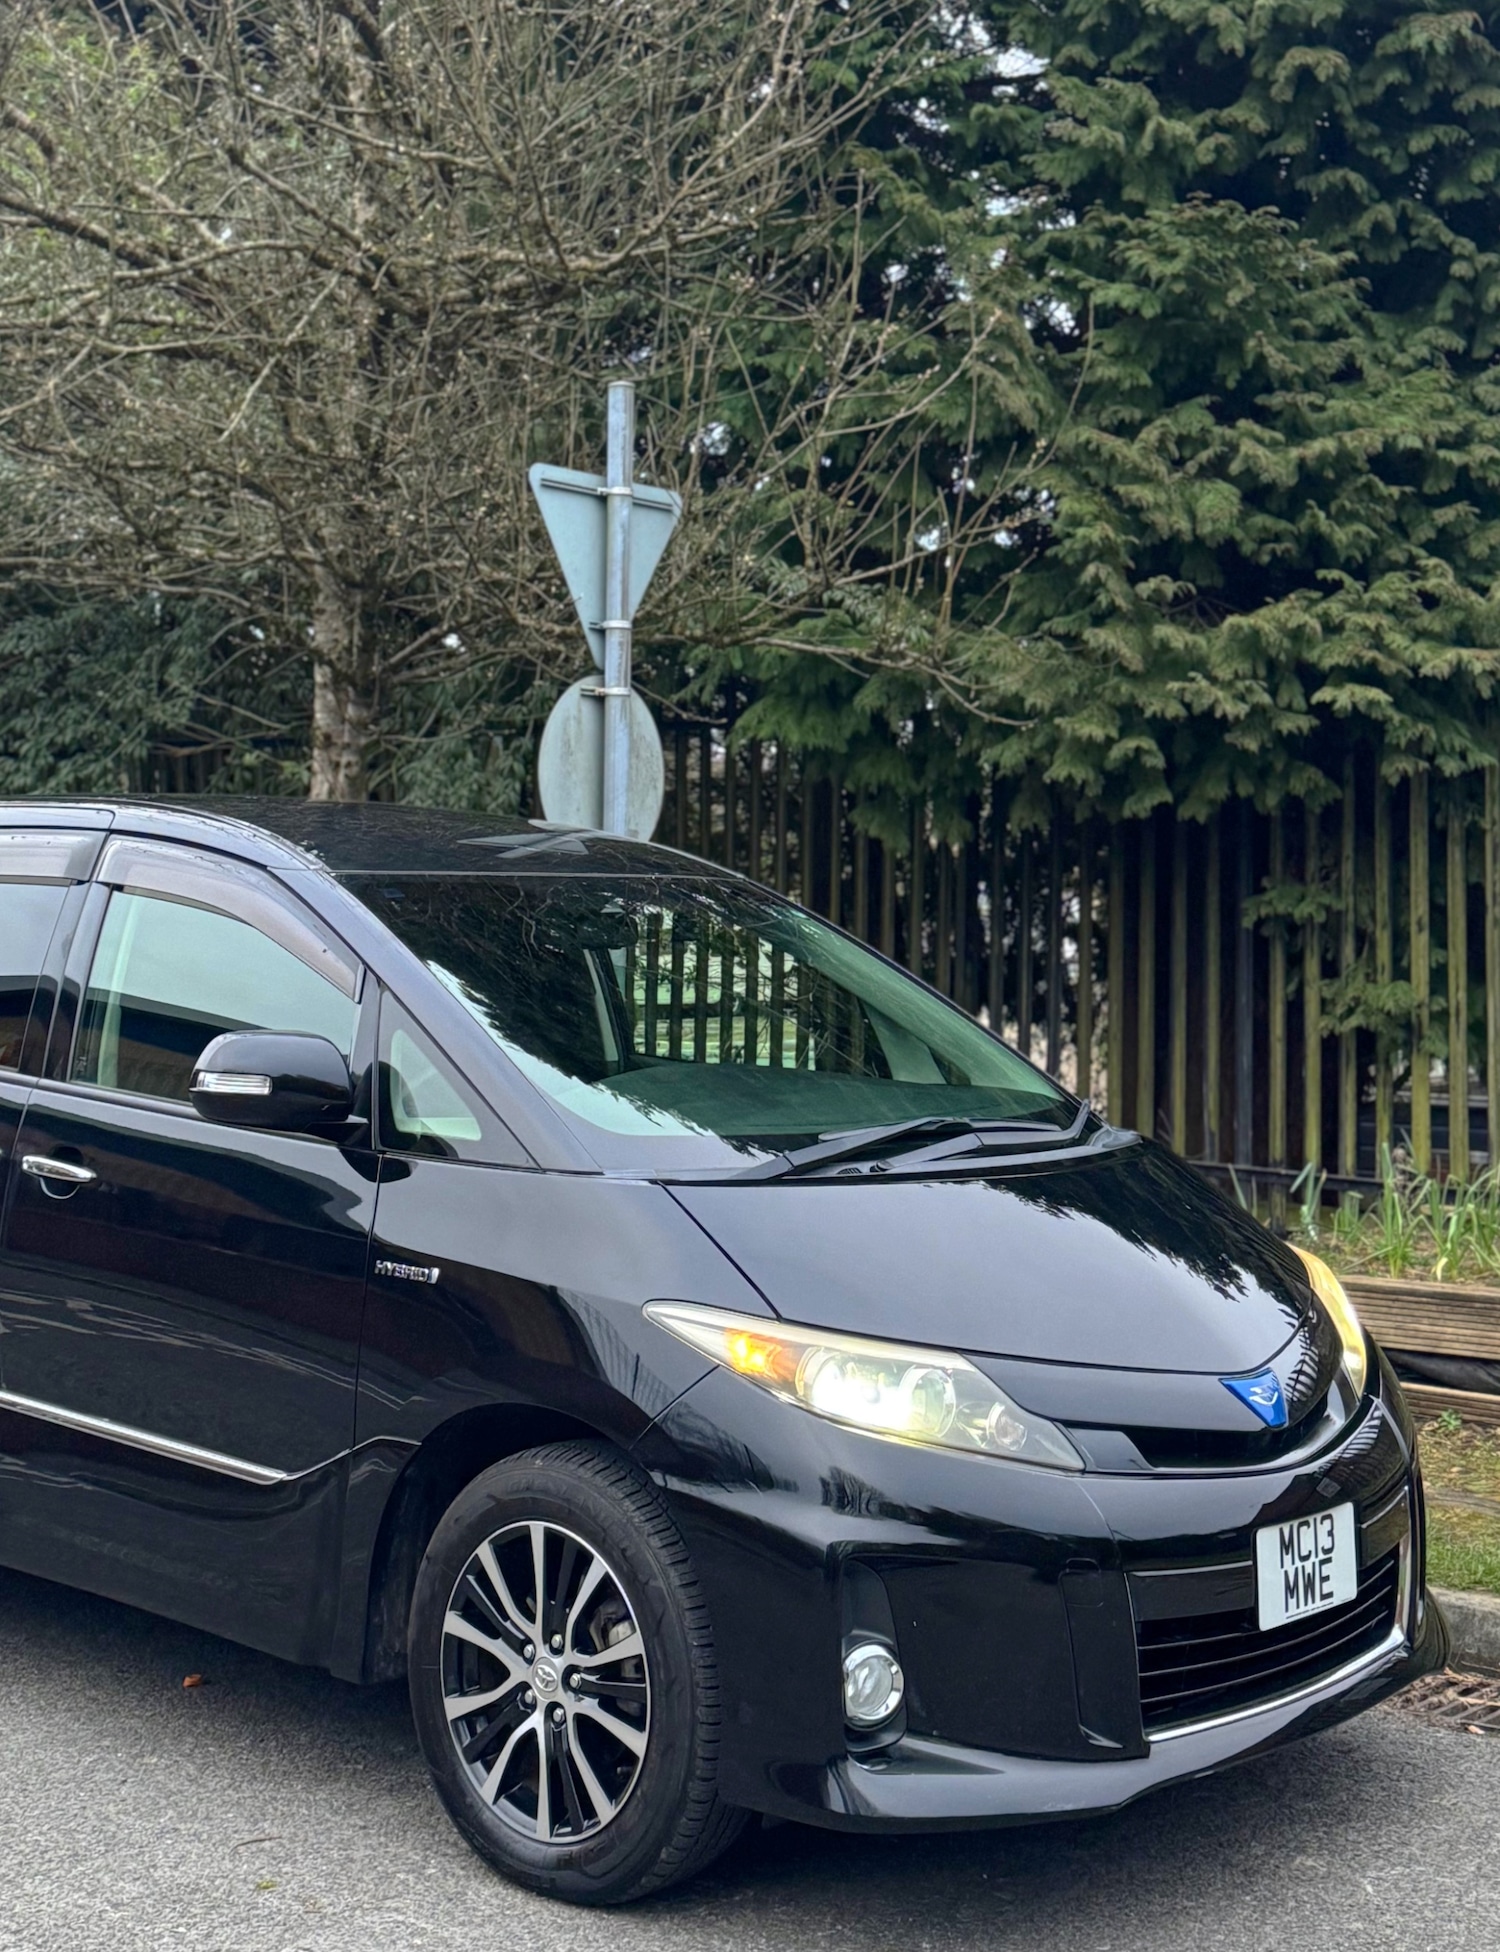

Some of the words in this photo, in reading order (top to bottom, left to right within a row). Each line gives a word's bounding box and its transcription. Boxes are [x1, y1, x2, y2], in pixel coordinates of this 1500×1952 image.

[374, 1259, 430, 1282] HYBRID
[1279, 1513, 1335, 1569] MC13
[1284, 1556, 1334, 1613] MWE
